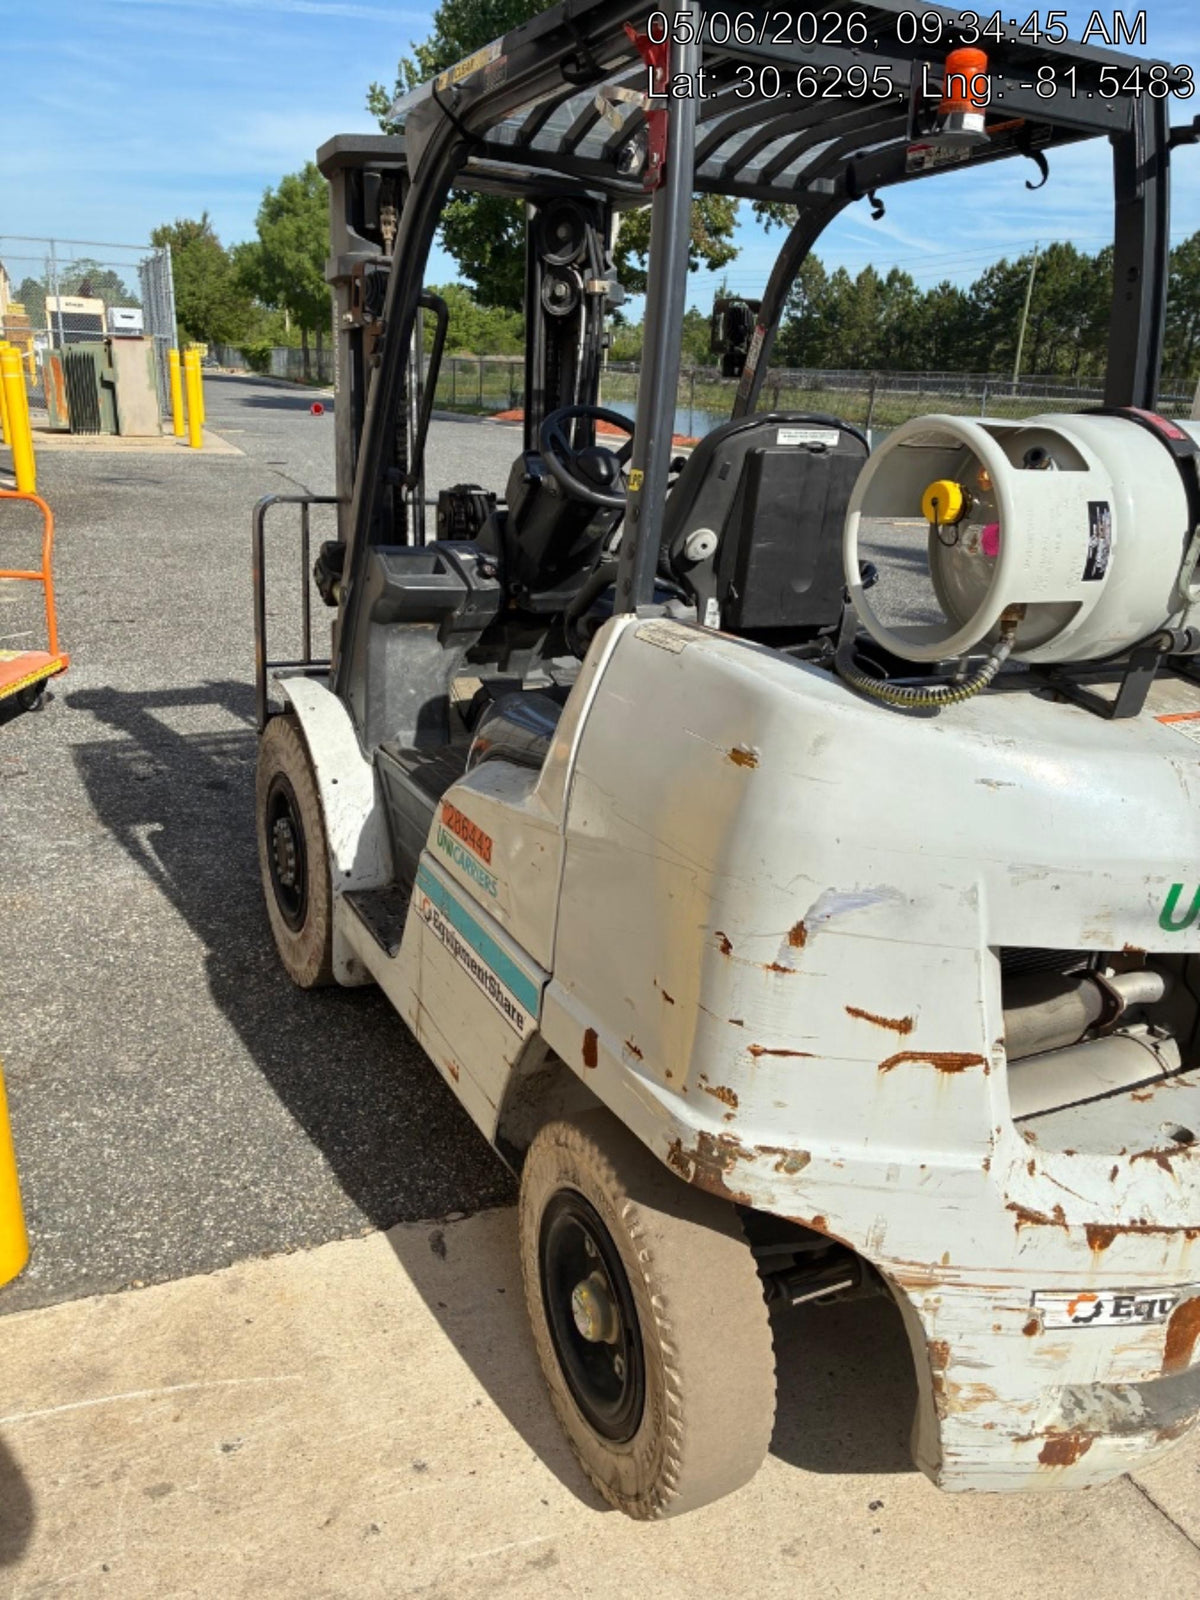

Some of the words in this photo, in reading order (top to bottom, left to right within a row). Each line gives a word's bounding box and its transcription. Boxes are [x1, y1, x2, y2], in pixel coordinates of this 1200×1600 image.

[446, 810, 493, 863] 286443
[1158, 883, 1200, 932] U
[432, 908, 525, 1032] EquipmentShare
